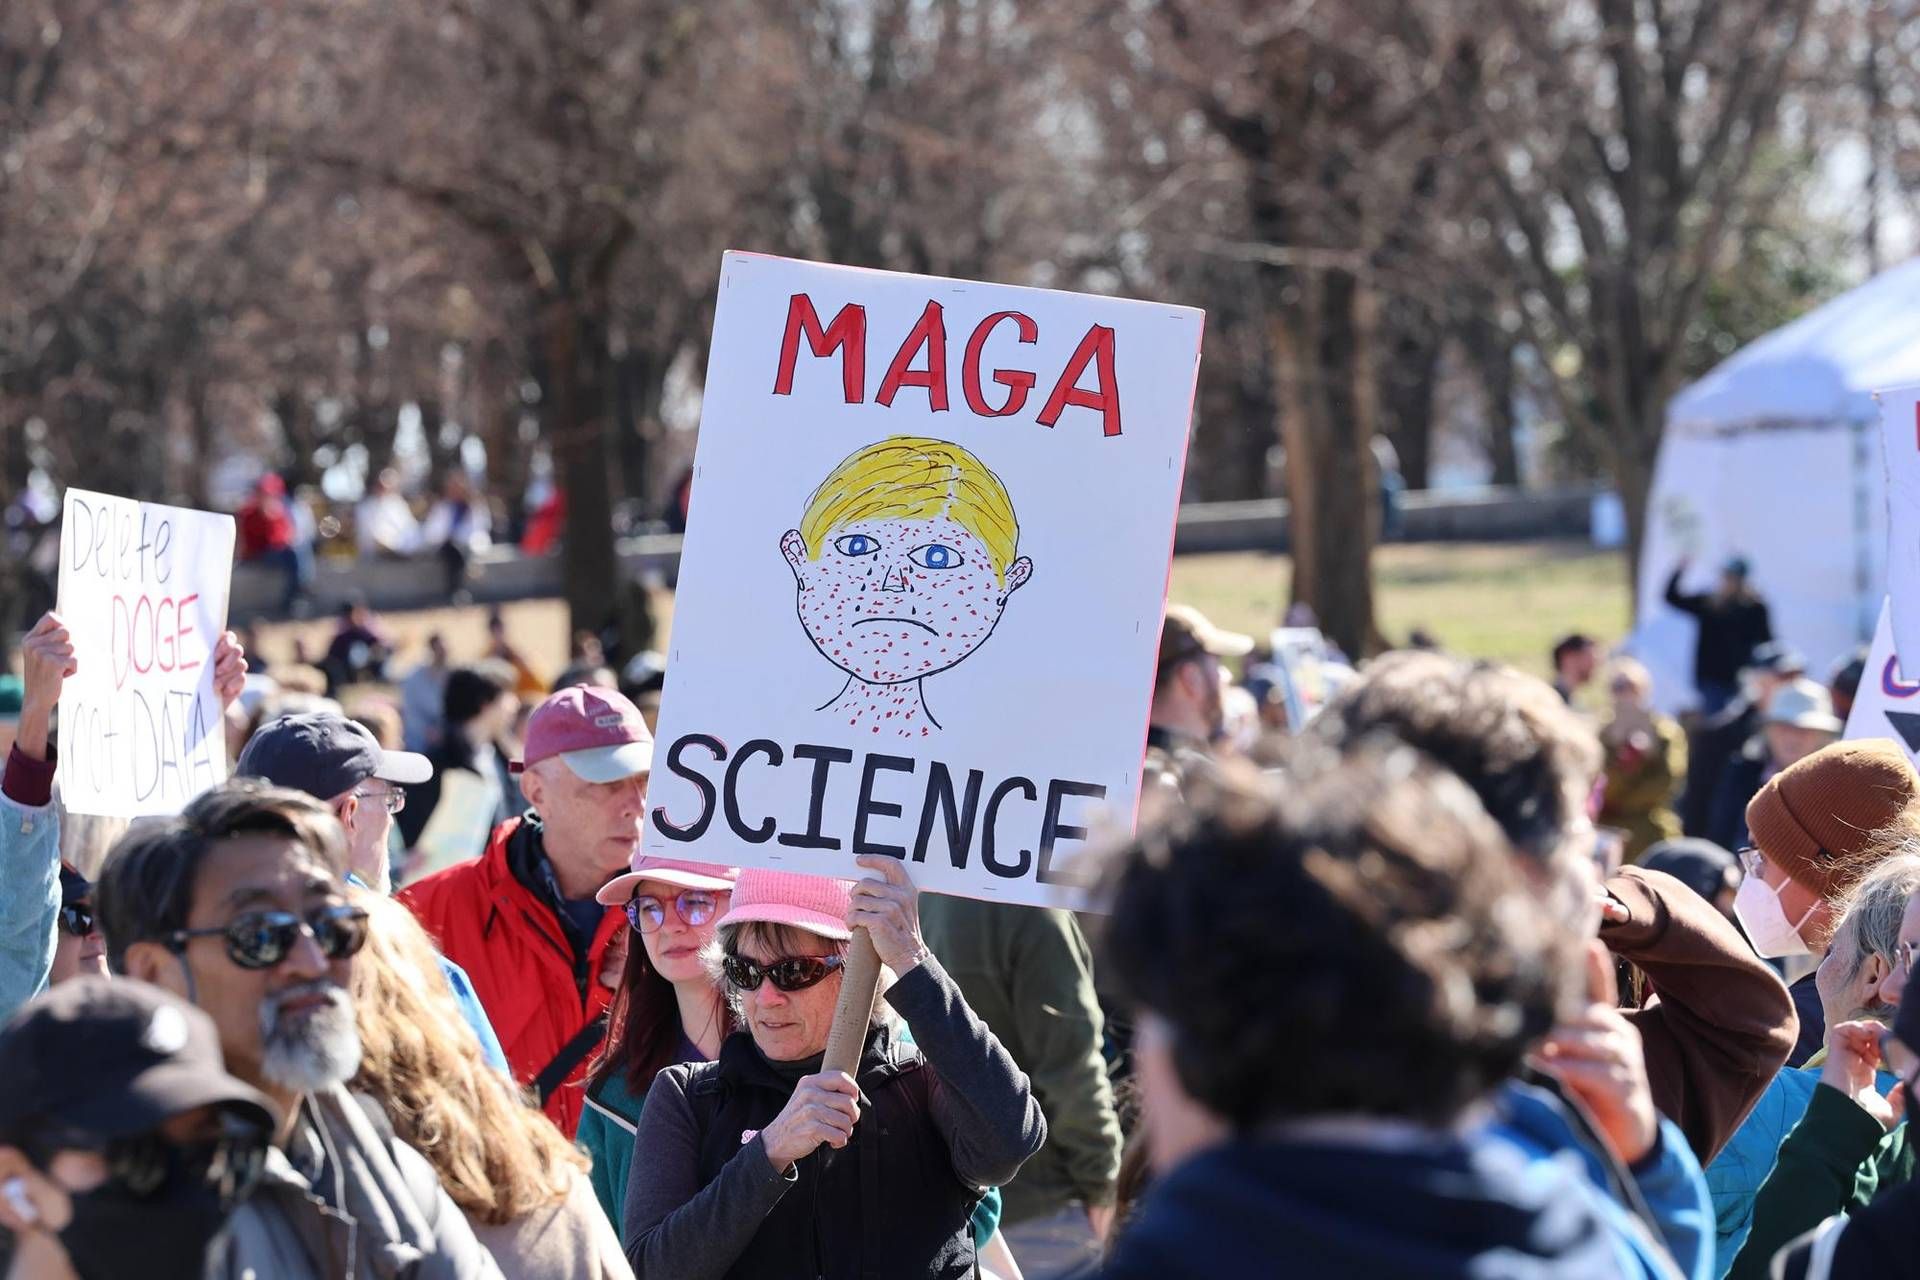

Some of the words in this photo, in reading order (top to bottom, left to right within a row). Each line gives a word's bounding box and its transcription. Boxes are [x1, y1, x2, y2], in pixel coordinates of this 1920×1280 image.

[773, 292, 1122, 437] MAGA
[73, 498, 171, 584] Delete
[112, 594, 200, 691] DOGE
[133, 689, 217, 802] DATA
[651, 733, 1107, 886] SCIENCE
